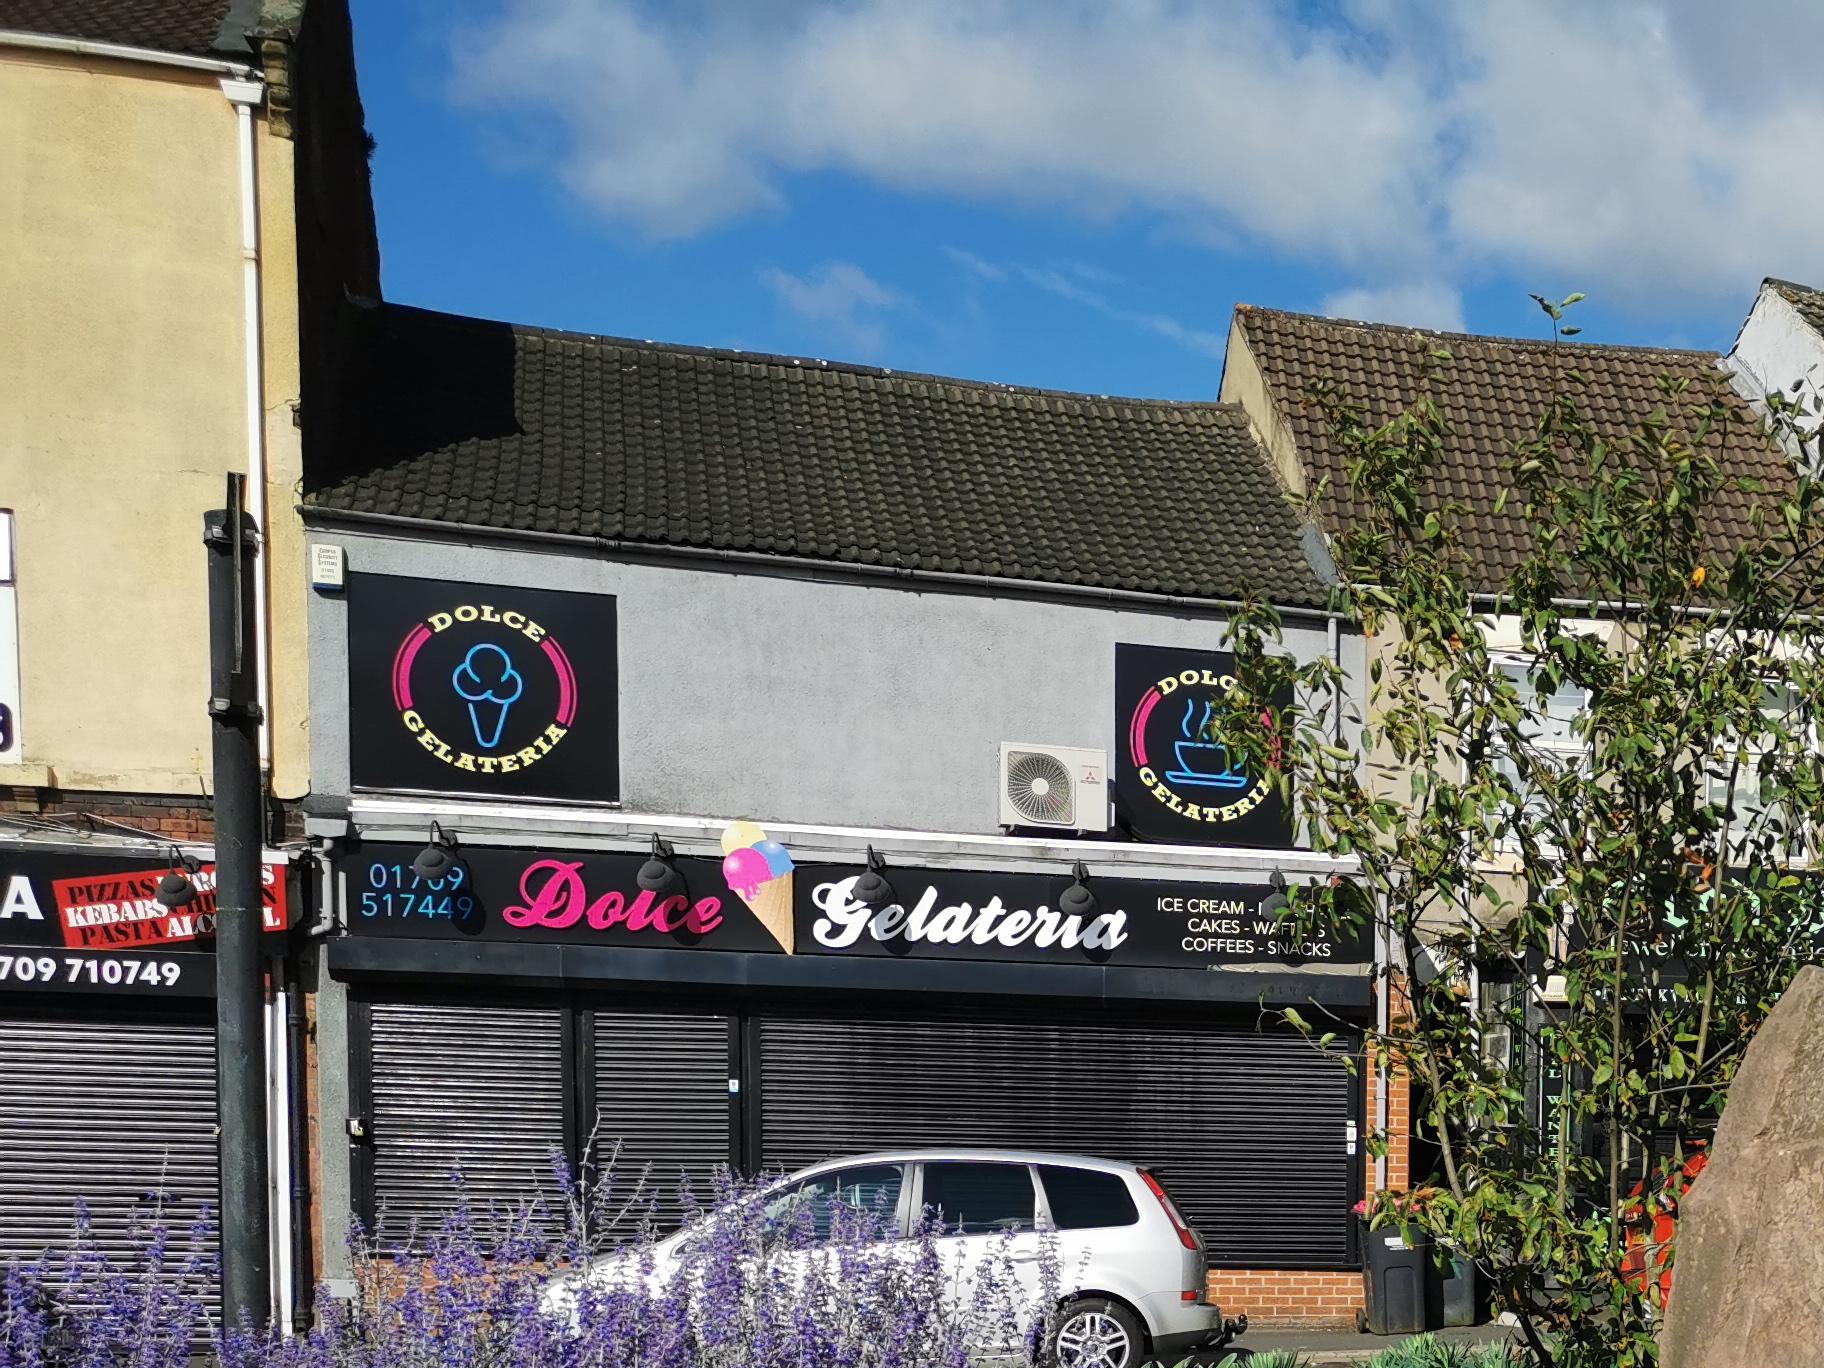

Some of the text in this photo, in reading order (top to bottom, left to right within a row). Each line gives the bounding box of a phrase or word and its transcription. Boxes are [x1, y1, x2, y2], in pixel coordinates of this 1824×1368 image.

[428, 605, 546, 642] DOLCE
[1158, 669, 1239, 696] DOLC
[403, 710, 568, 774] GELATERIA
[68, 878, 156, 905] PIZZAS
[64, 898, 168, 928] KEBABS
[361, 892, 474, 920] 517449
[812, 875, 1128, 949] Gelateria
[1157, 896, 1183, 912] ICE
[1187, 898, 1244, 915] CREAM
[80, 922, 163, 946] PASTA
[1187, 918, 1240, 934] CAKES
[1181, 937, 1254, 954] COFFEES
[1267, 941, 1331, 957] SNACKS
[65, 959, 181, 986] 710749
